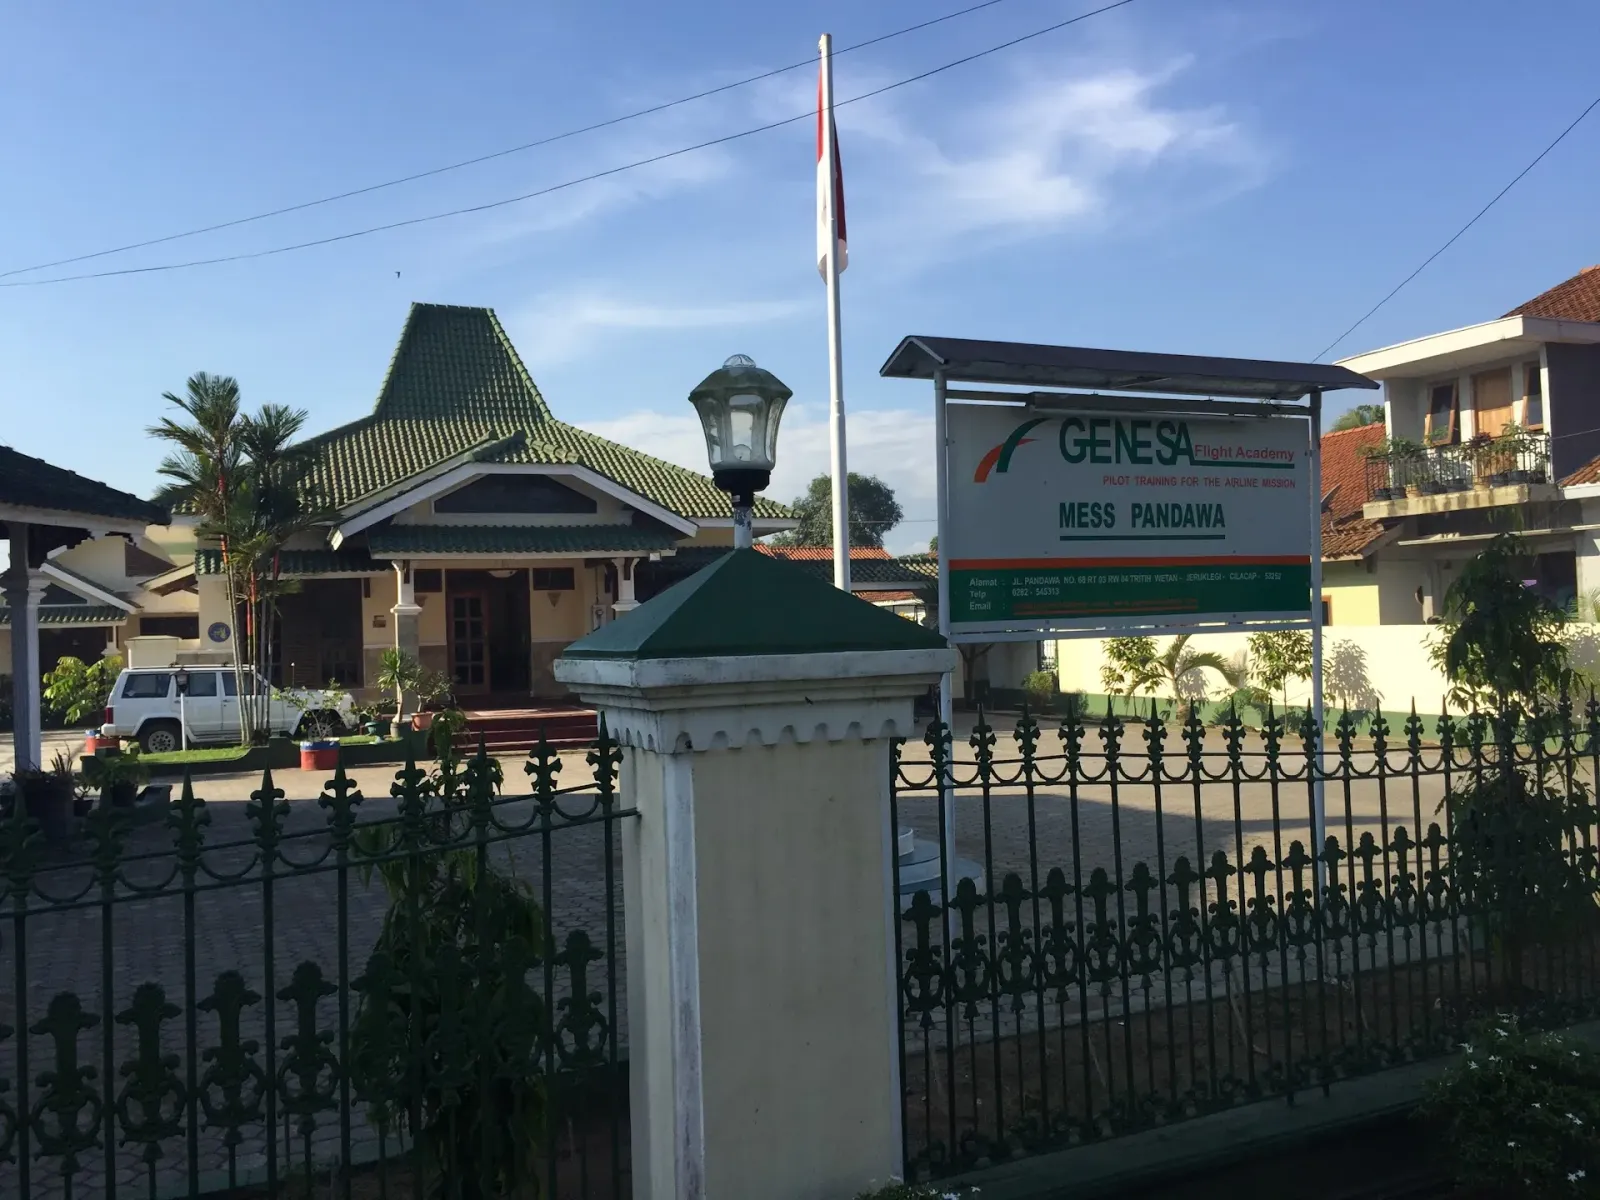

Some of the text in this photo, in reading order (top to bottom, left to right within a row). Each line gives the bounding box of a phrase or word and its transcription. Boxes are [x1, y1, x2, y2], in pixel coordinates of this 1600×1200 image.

[1059, 417, 1295, 466] GENESA Flight Academy
[1103, 475, 1296, 489] PILOT TRAINING FOR THE AIRLINE MISSION
[1059, 502, 1226, 529] MESS PANDAWA
[969, 578, 998, 587] Alamat
[1024, 576, 1060, 585] PANDAWA
[970, 590, 987, 599] Telp
[969, 602, 991, 611] Email
